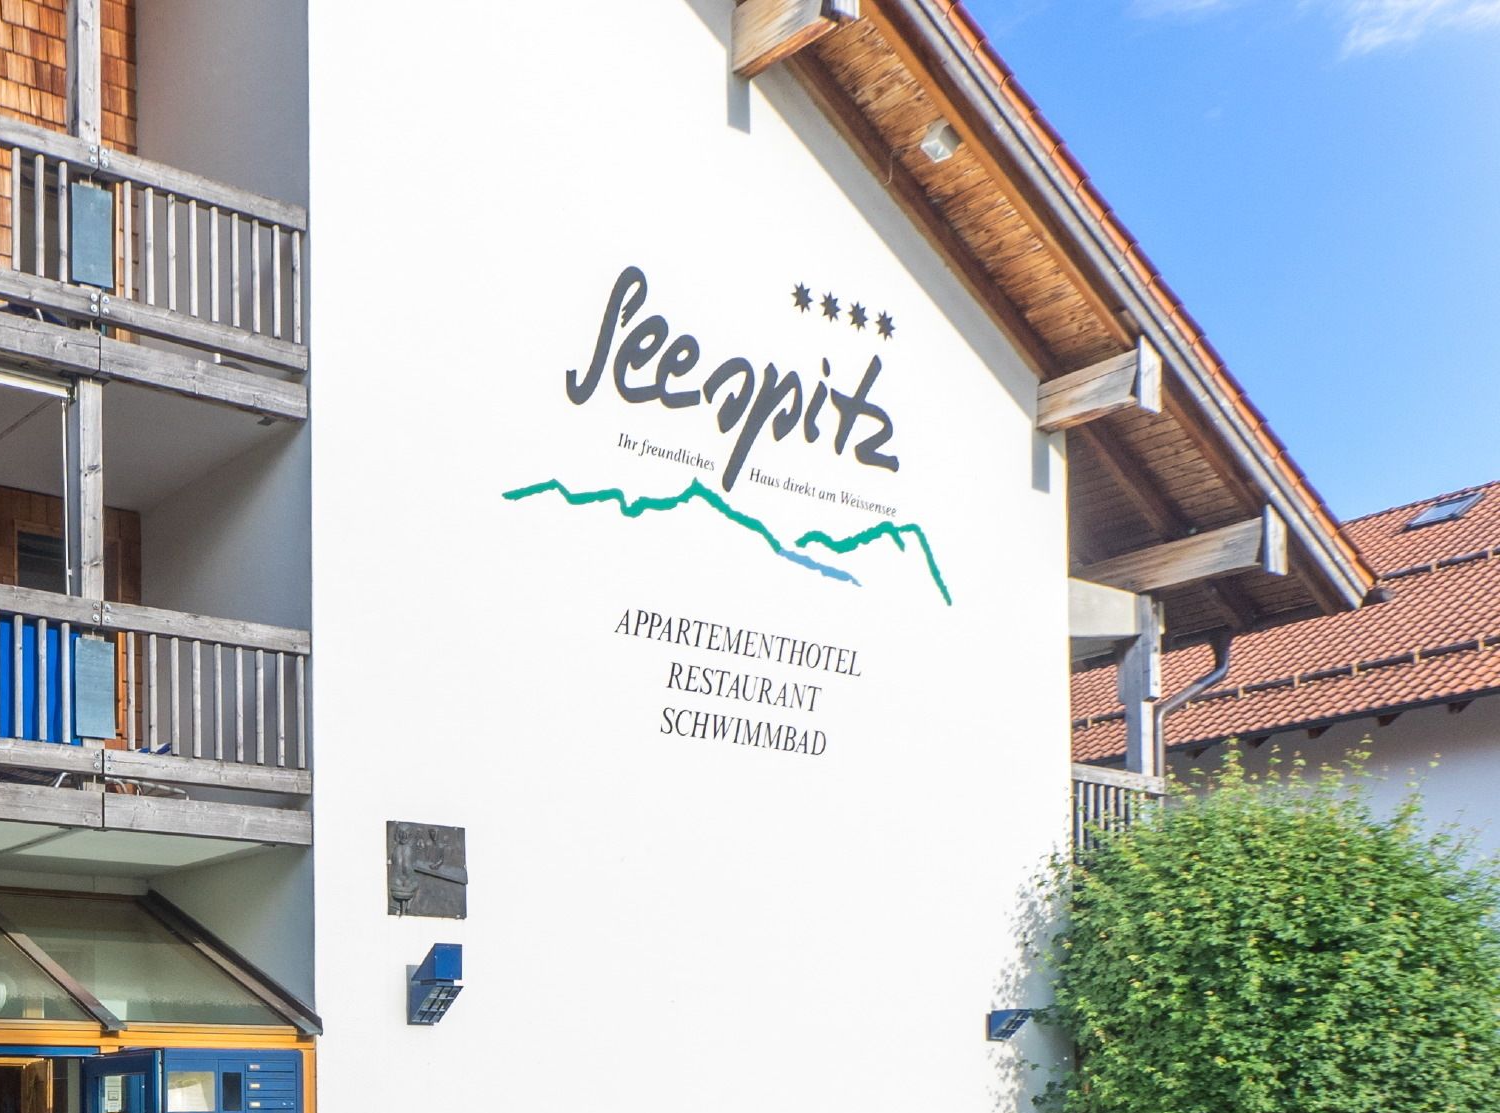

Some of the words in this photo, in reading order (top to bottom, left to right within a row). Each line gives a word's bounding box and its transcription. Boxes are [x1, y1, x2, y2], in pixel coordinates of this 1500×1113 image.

[565, 265, 900, 493] Seespitz
[617, 432, 638, 451] Ihr
[638, 439, 716, 472] freundliches
[749, 467, 780, 489] Haus
[782, 477, 816, 498] direkt
[818, 489, 836, 503] am
[840, 490, 897, 518] Weissensee
[614, 608, 862, 677] APPARTEMENTHOTEL
[666, 661, 822, 713] RESTAURANT
[659, 706, 827, 756] SCHWIMMBAD
